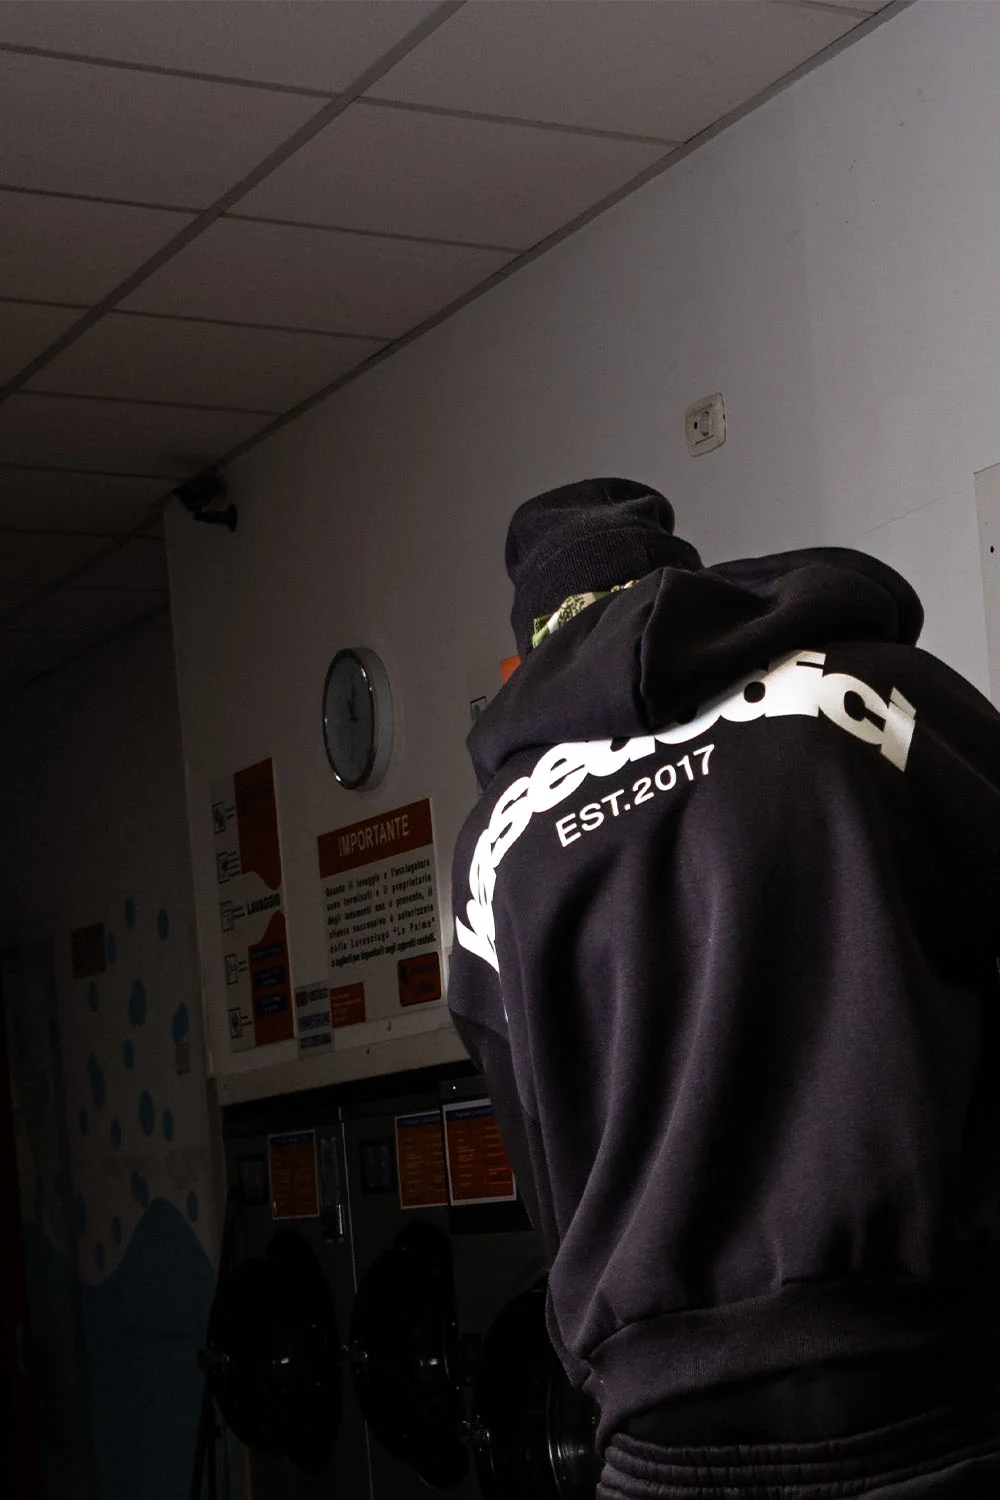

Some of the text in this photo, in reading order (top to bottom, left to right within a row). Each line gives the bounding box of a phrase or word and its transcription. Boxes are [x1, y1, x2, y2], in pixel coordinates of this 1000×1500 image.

[555, 743, 715, 848] EST.2017
[337, 814, 410, 857] IMPORTANTE
[247, 894, 281, 915] LAVAGGIO
